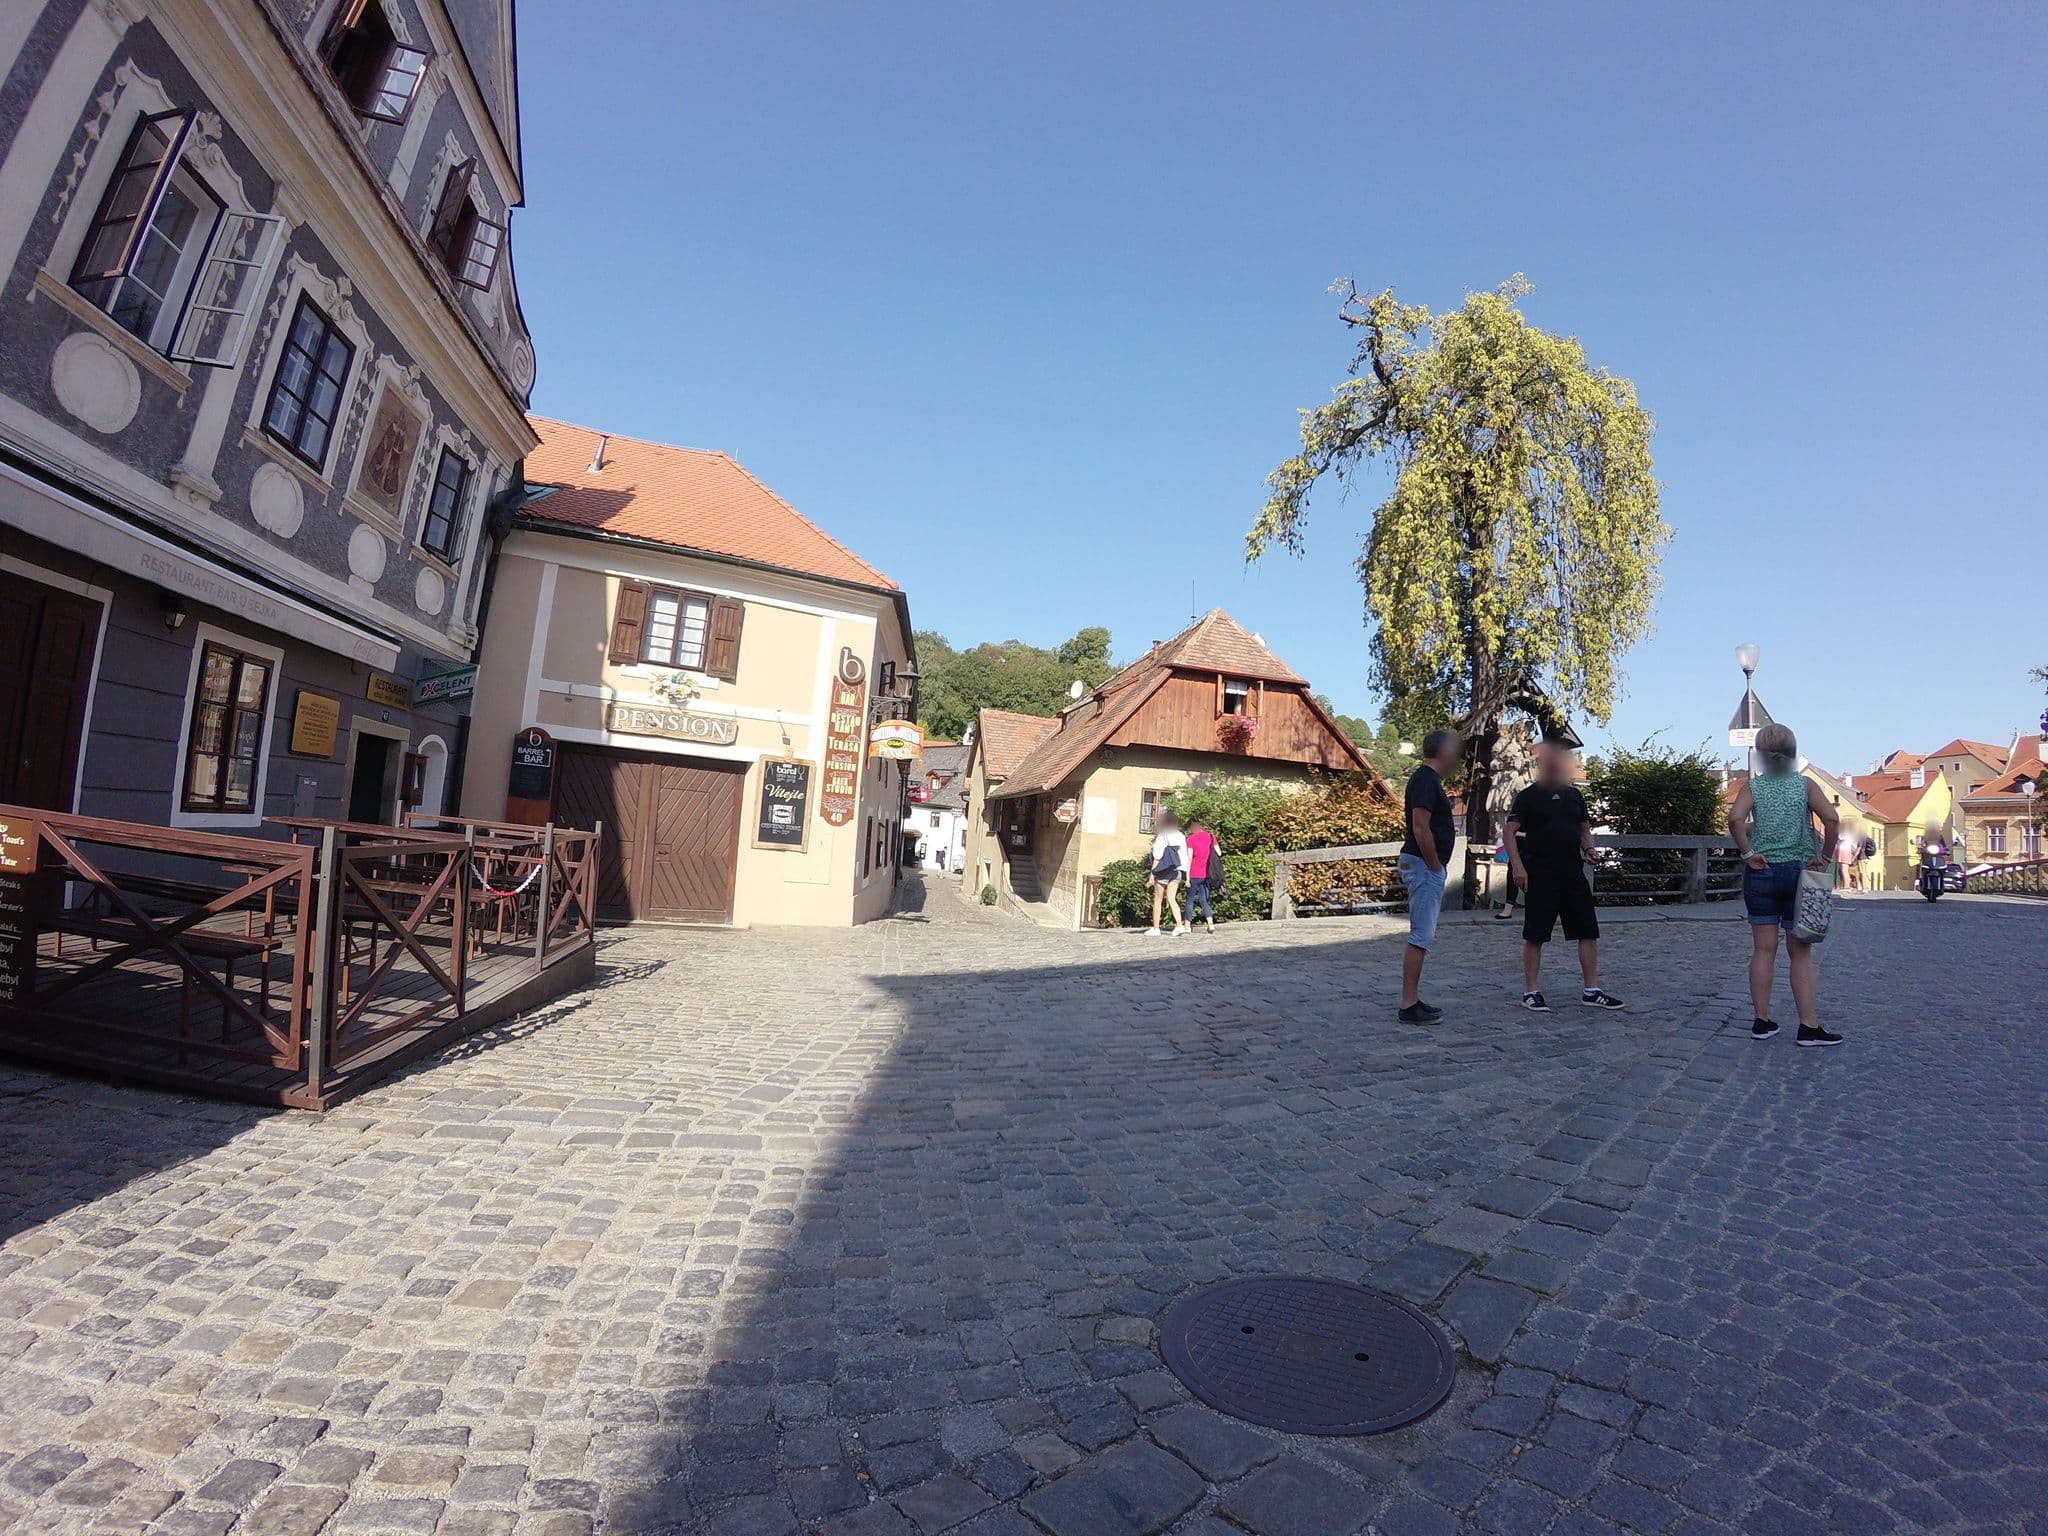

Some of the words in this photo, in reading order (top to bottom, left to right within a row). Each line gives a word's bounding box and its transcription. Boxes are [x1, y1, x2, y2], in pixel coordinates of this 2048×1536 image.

[612, 707, 728, 741] PENSION
[517, 747, 545, 757] BARREL
[524, 754, 543, 764] BAR
